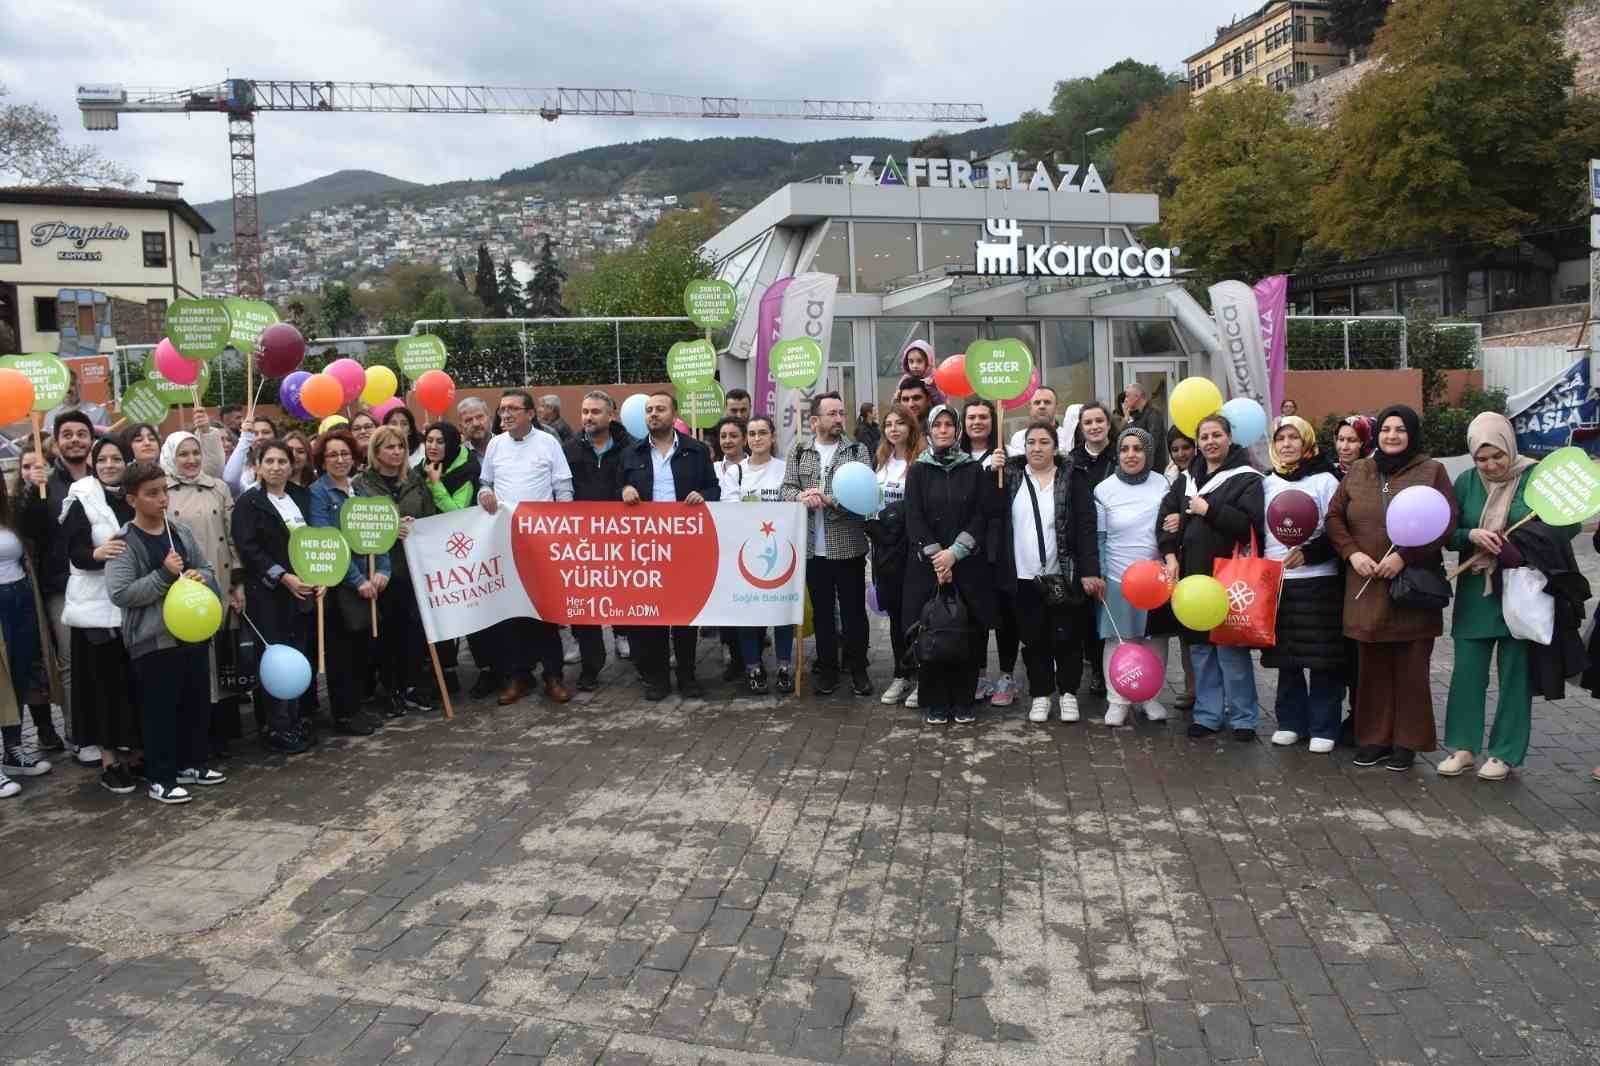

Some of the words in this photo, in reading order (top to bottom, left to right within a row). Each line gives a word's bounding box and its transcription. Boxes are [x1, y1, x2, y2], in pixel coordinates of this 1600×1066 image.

[851, 153, 977, 189] ZAFER
[987, 159, 1106, 194] PLAZA
[31, 221, 129, 249] Payidar
[1027, 243, 1171, 278] karaca
[1223, 304, 1250, 394] karaca
[518, 515, 584, 534] HAYAT
[590, 512, 704, 535] HASTANESİ
[300, 539, 320, 549] HER
[320, 538, 340, 549] GÜN
[304, 551, 337, 561] 10.000
[550, 538, 624, 562] SAĞLIK
[631, 539, 672, 565] İÇİN
[310, 563, 333, 572] ADIM
[425, 555, 502, 593] HAYAT
[560, 565, 663, 588] YÜRÜYOR
[427, 576, 506, 609] HASTANESİ
[566, 596, 585, 606] Her
[567, 607, 585, 617] gün
[587, 596, 613, 617] 10
[609, 607, 624, 617] bin
